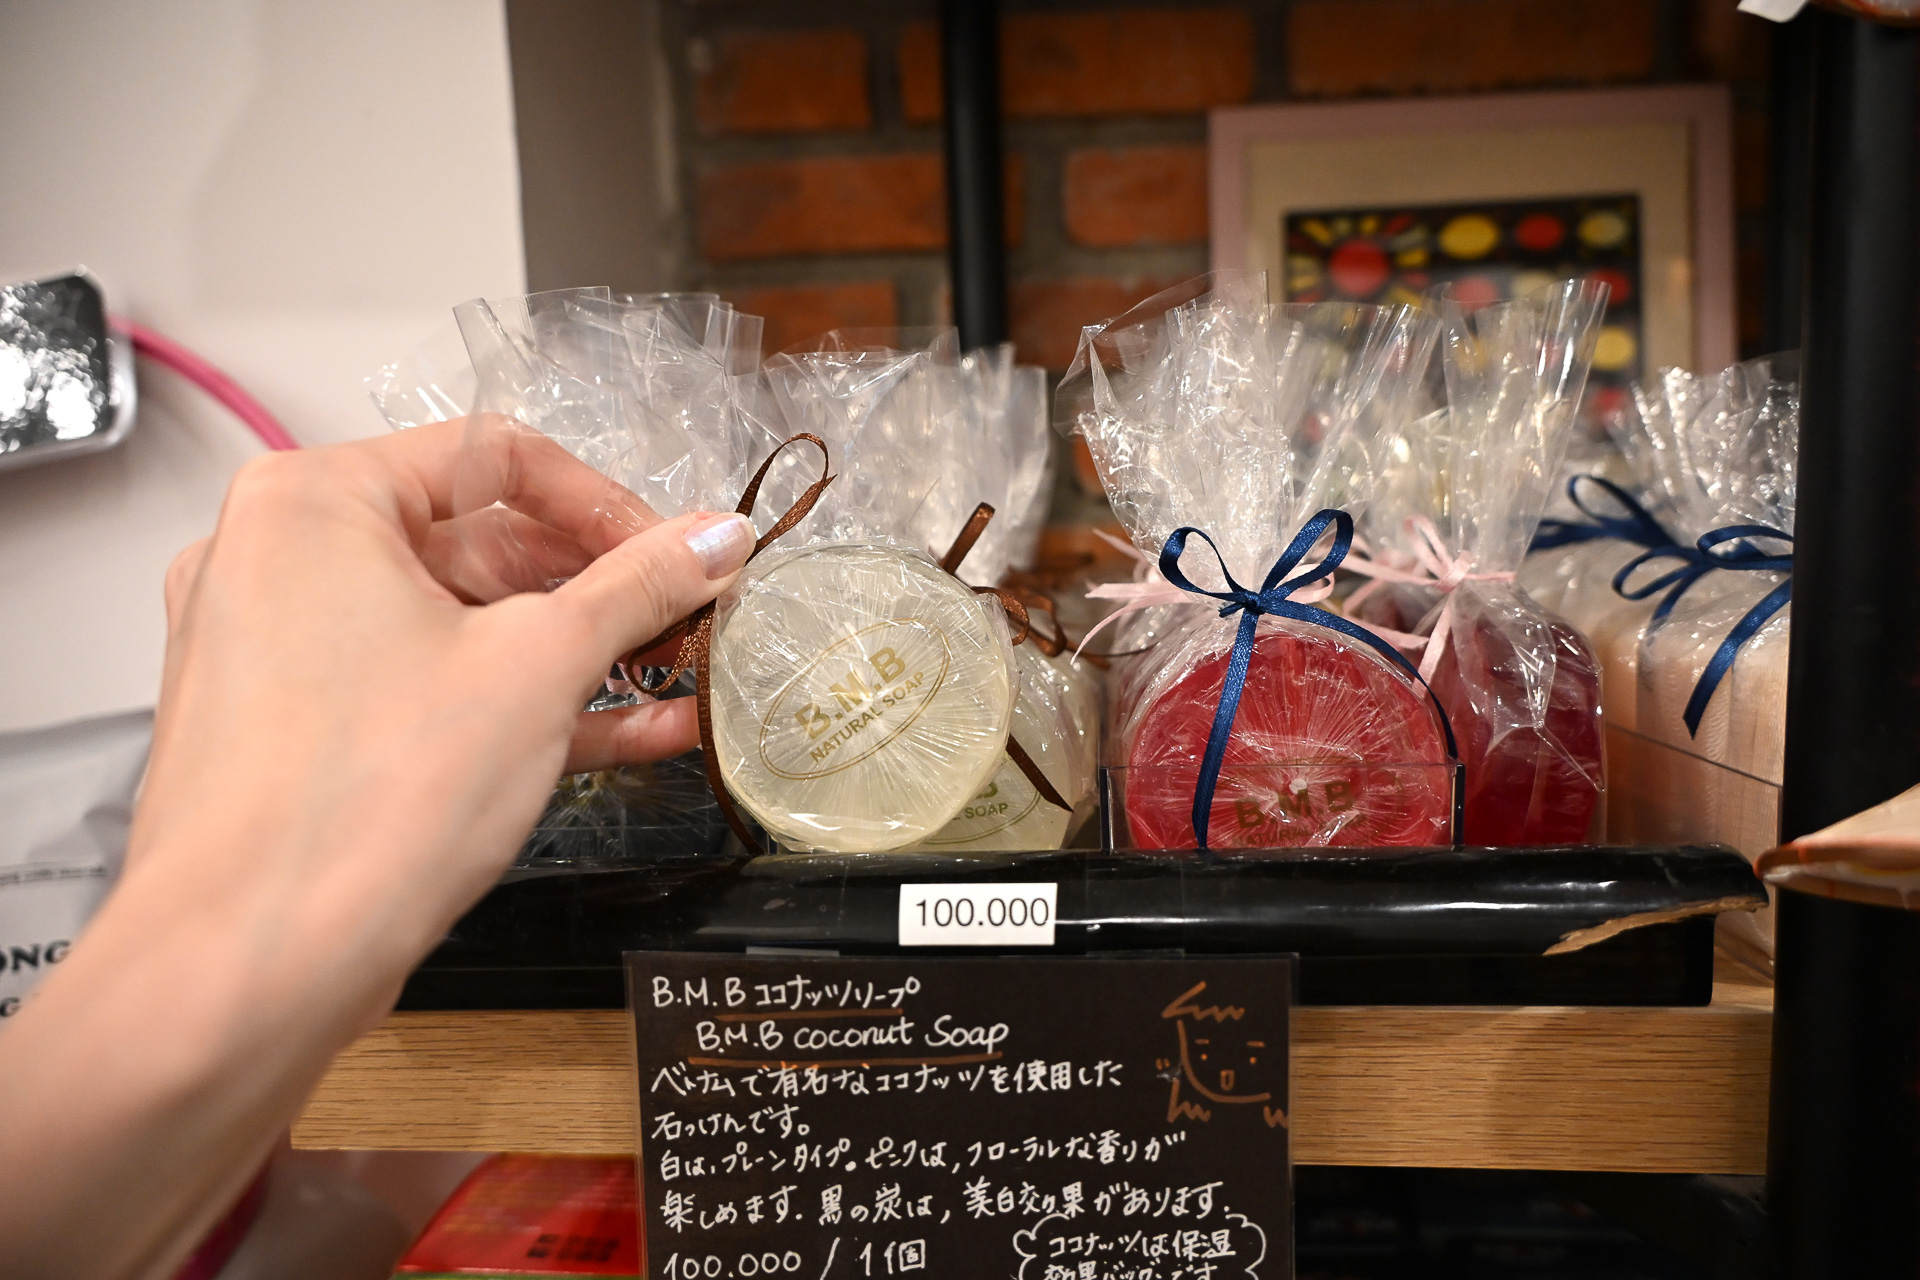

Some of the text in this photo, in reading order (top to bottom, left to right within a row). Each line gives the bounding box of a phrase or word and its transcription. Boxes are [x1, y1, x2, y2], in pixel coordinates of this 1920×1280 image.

[809, 671, 925, 763] NATURAL SOAP
[964, 802, 1008, 819] SOAP
[915, 898, 1049, 927] 100.000
[695, 1014, 1010, 1055] B.M.B coconut Soap
[663, 1250, 802, 1280] 100.000
